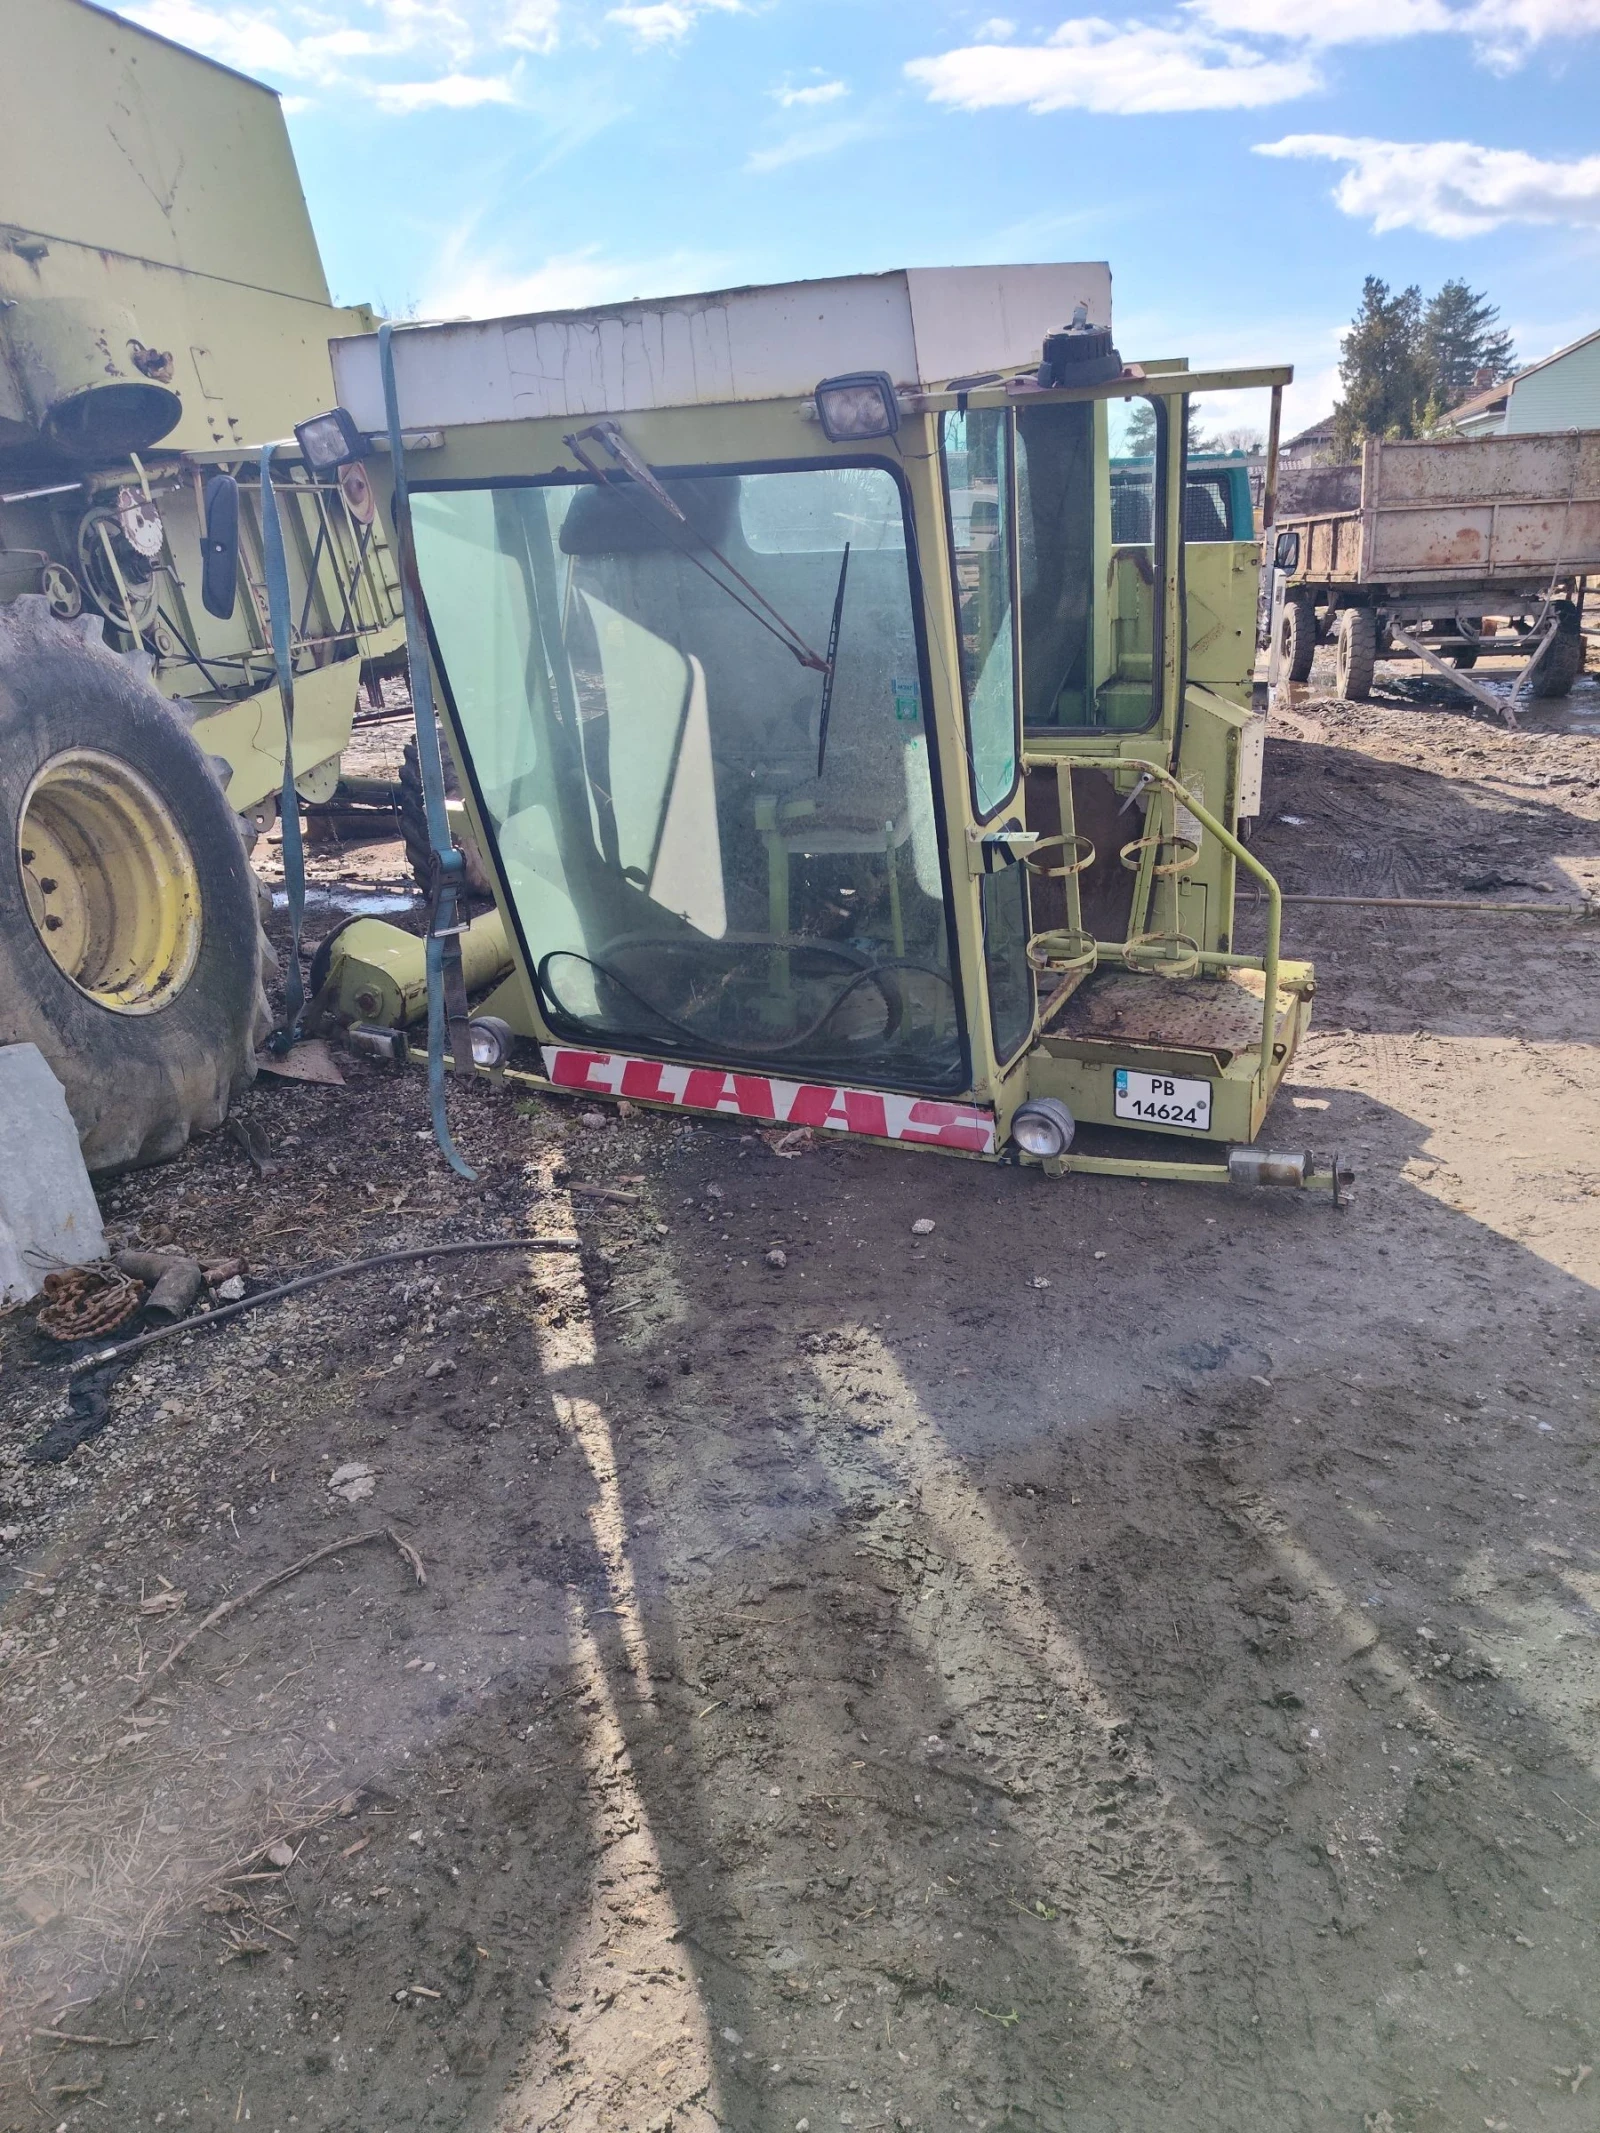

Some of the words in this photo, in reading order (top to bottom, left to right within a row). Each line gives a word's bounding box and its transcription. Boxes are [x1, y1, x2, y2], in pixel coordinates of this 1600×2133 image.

[1151, 1078, 1175, 1096] PB
[551, 1050, 994, 1152] CLAAS
[1132, 1100, 1197, 1123] 14624
